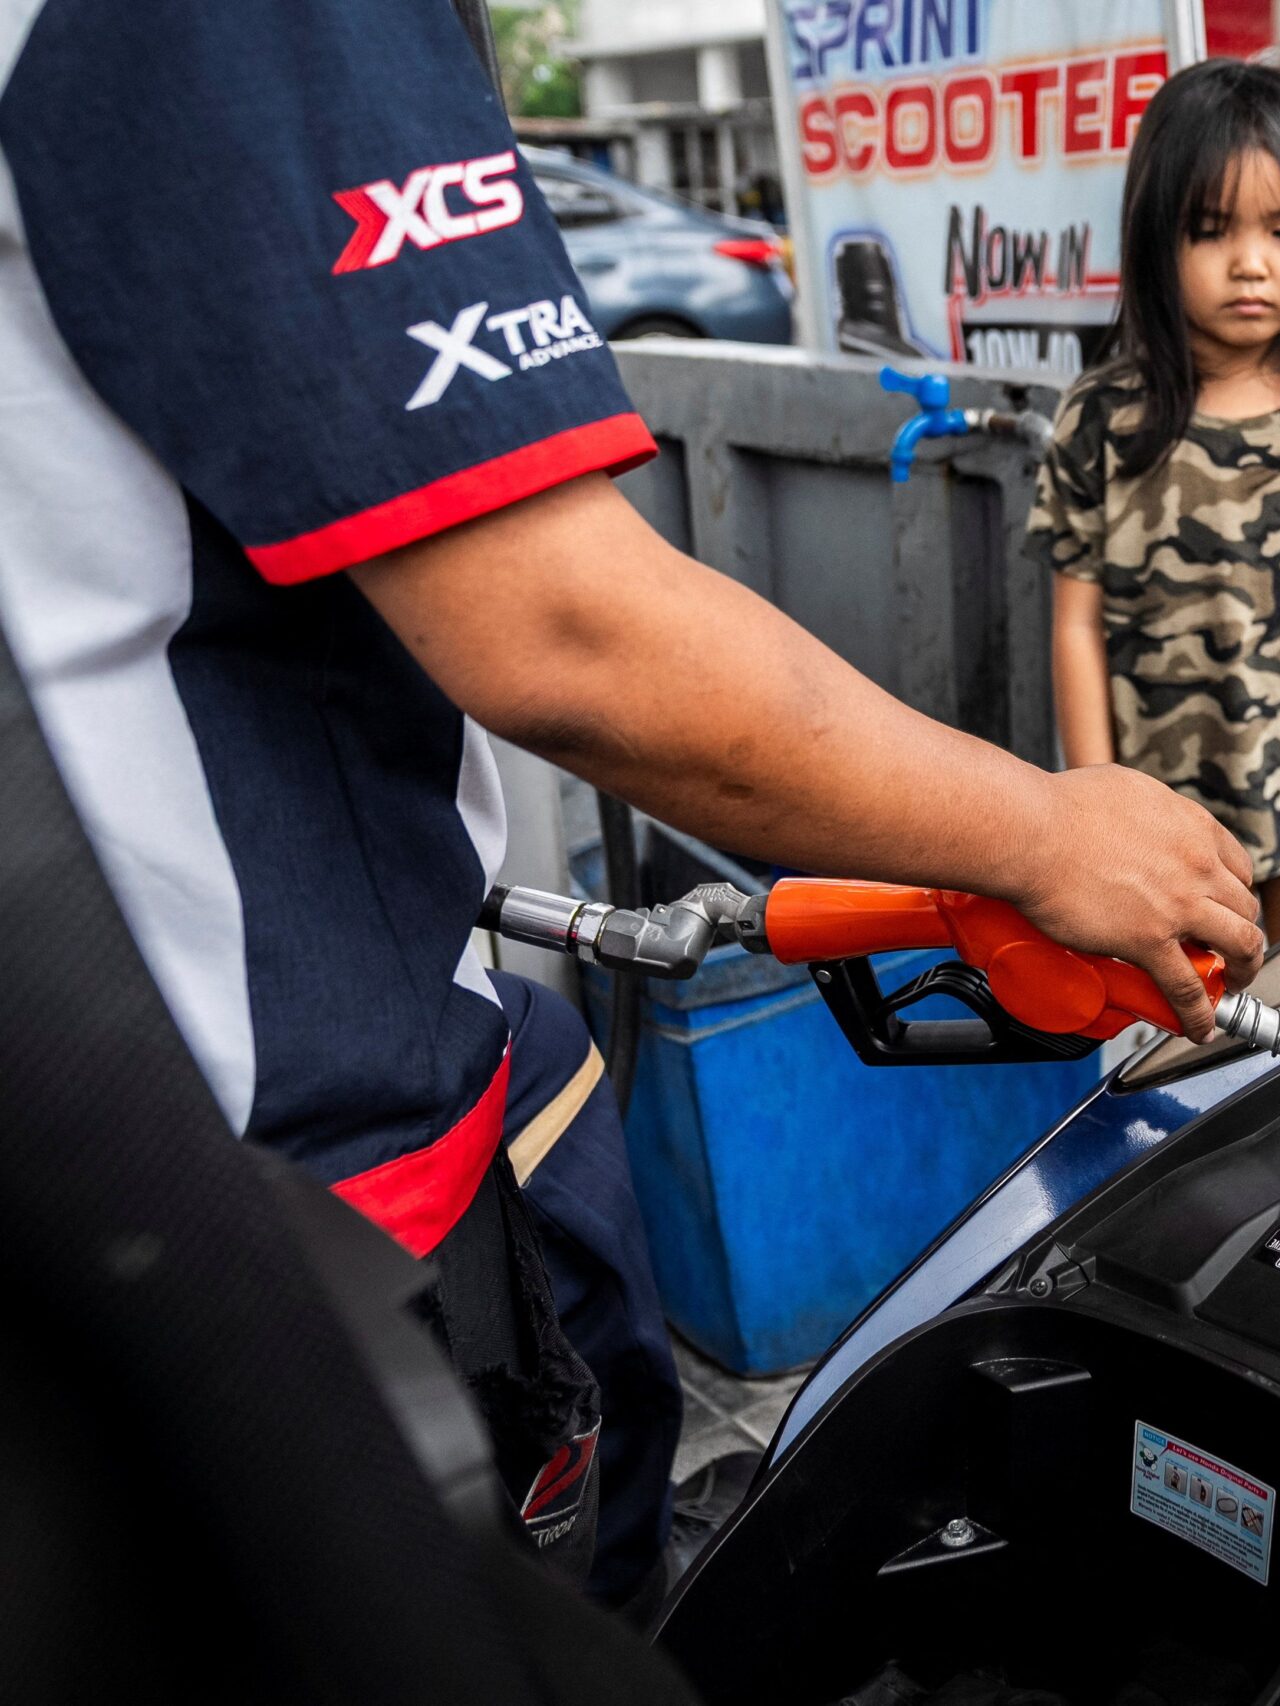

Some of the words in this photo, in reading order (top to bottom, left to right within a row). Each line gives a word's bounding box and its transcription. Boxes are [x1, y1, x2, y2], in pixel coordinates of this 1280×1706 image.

[802, 51, 1168, 174] SCOOTER
[362, 151, 525, 268] XCS
[1144, 1430, 1165, 1446] NOTICE
[1187, 1452, 1199, 1462] use
[1200, 1458, 1219, 1473] Honda
[1220, 1468, 1244, 1486] Original
[1243, 1480, 1259, 1495] Parts
